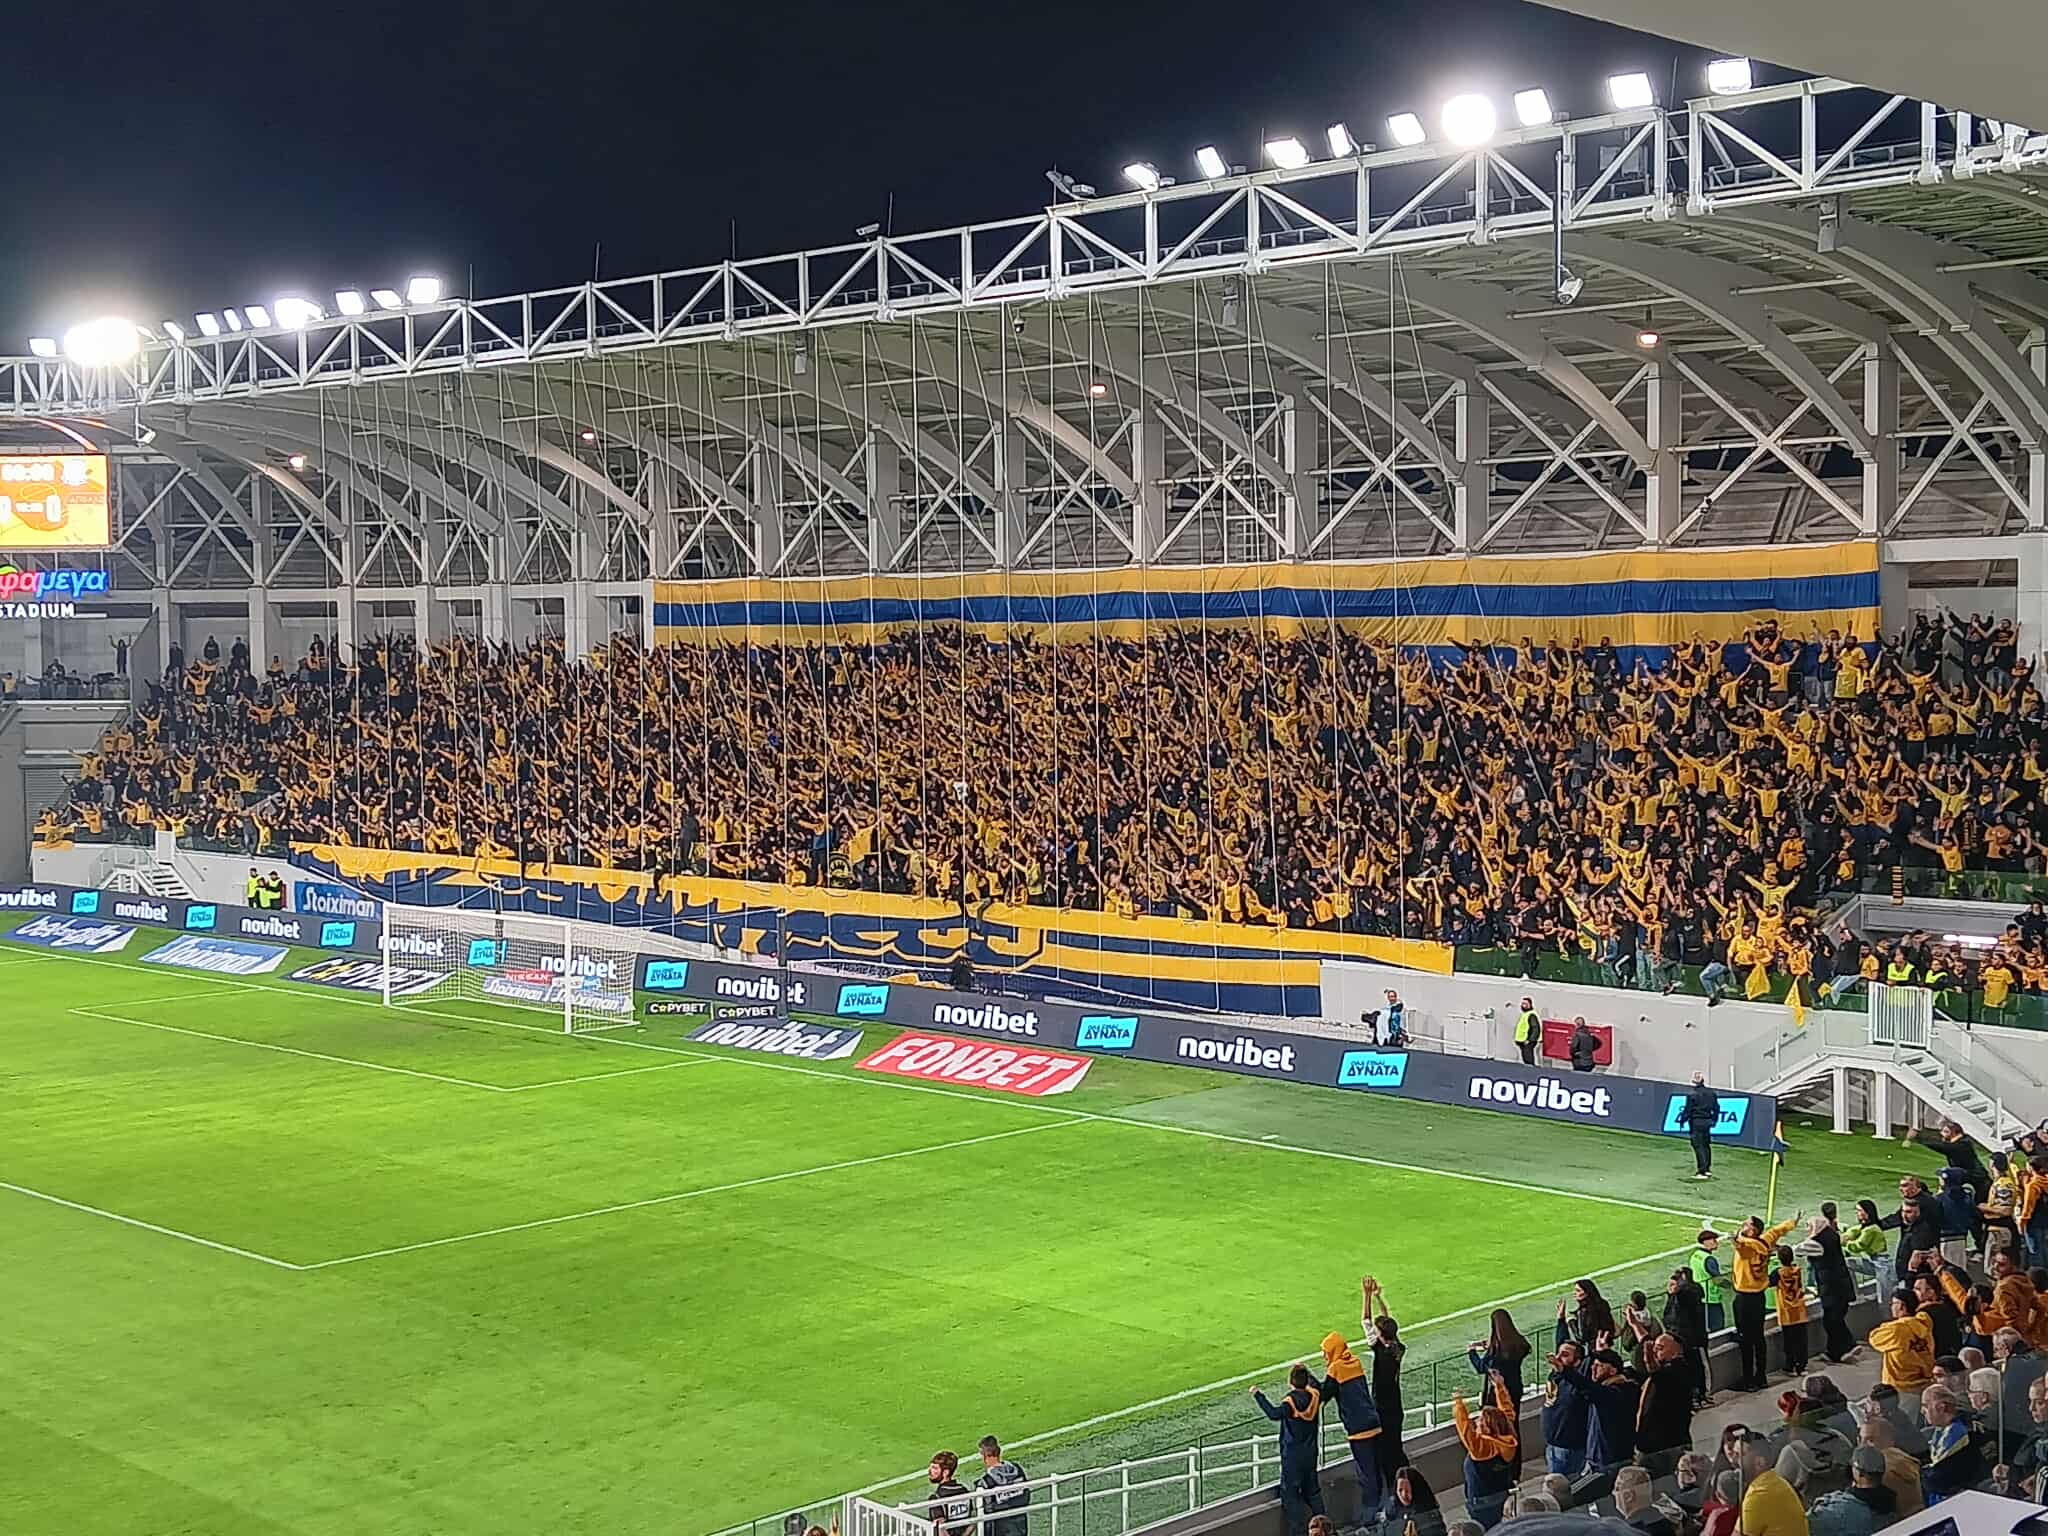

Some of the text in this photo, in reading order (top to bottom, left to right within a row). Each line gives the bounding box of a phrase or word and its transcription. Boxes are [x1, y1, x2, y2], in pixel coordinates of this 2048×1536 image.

[115, 901, 169, 922] novibet
[303, 886, 375, 917] Stoiximan
[241, 917, 301, 939] novibet
[934, 1003, 1040, 1035] novibet
[695, 1021, 843, 1056] novibet
[1178, 1036, 1296, 1071] novibet
[867, 1037, 1080, 1089] FONBET
[1469, 1076, 1612, 1116] novibet
